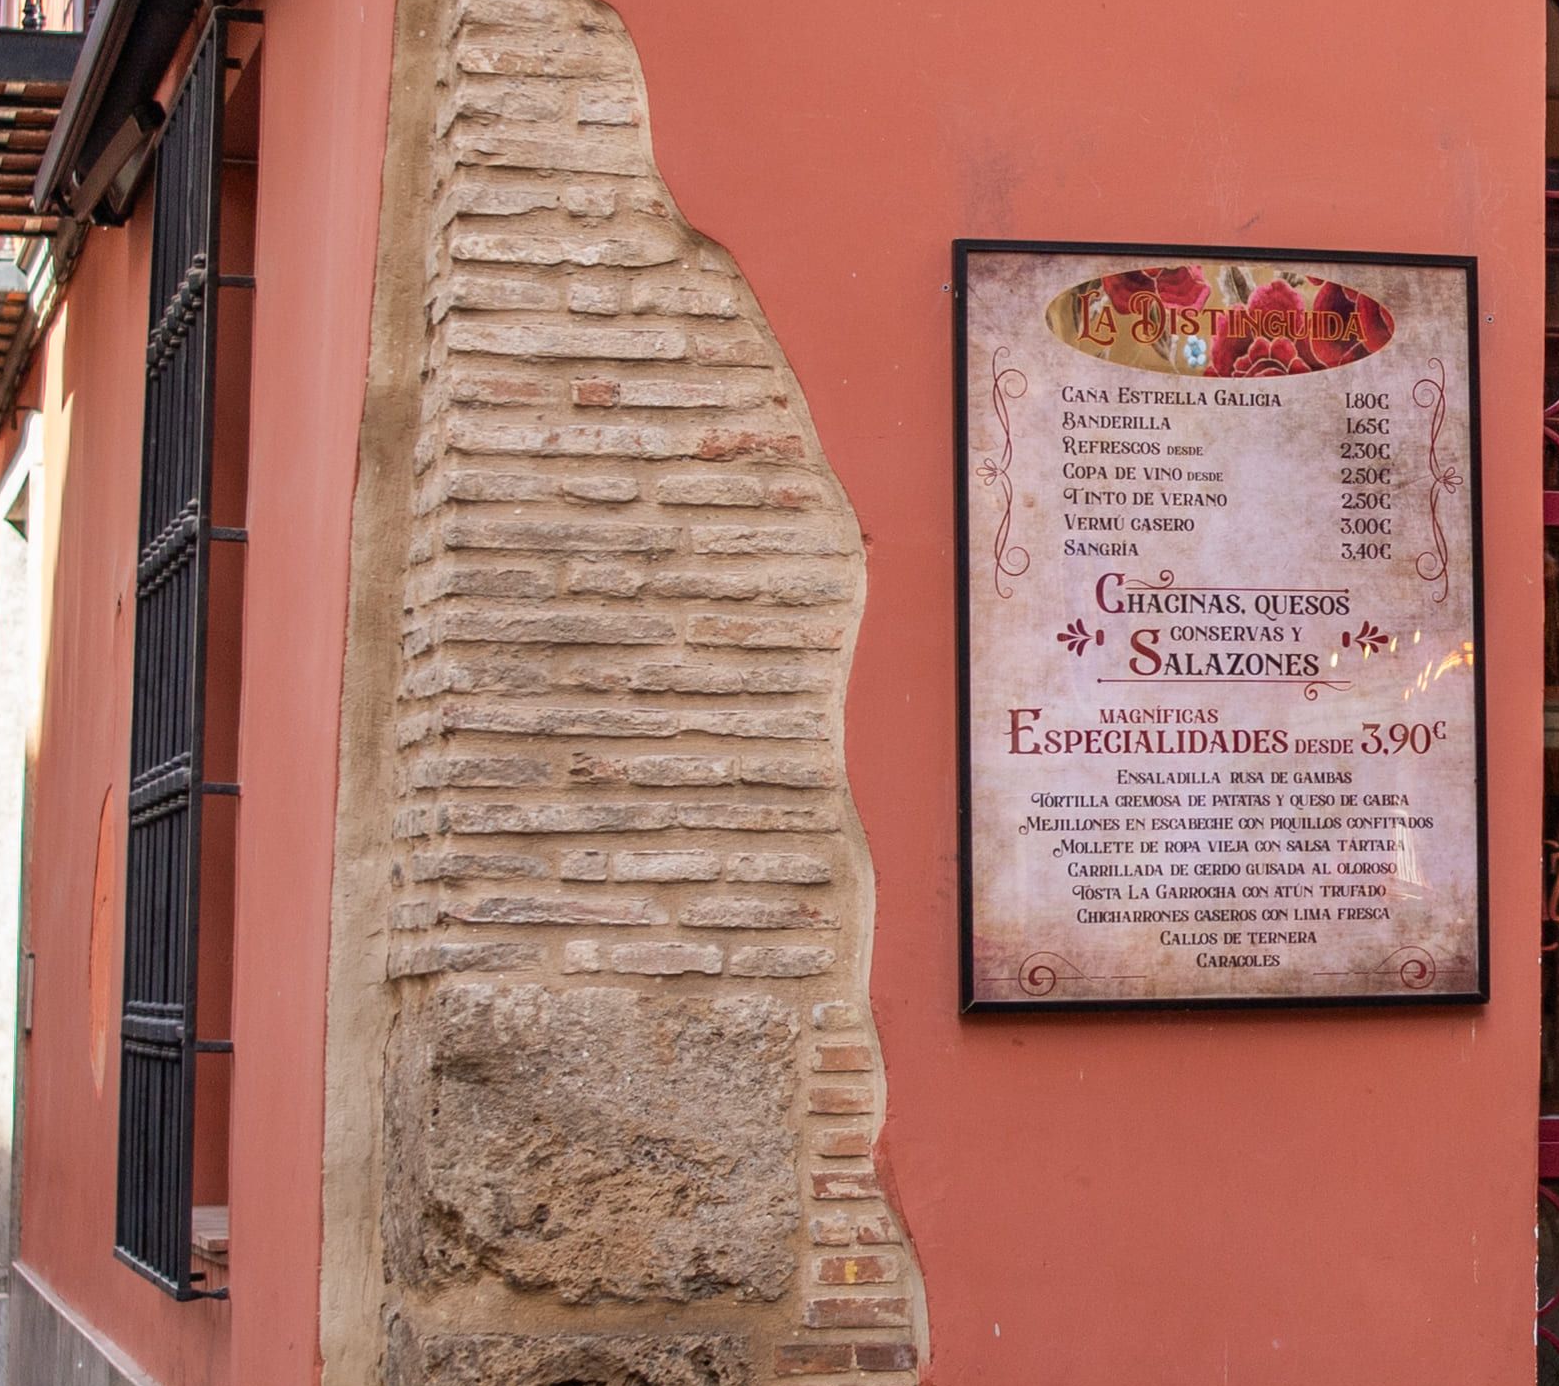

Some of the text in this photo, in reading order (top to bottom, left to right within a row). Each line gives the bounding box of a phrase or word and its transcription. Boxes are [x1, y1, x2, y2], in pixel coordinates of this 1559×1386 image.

[1078, 291, 1367, 345] LA DISTINGUIDA
[1061, 386, 1109, 403] CAÑA
[1118, 389, 1207, 405] ESTRELLA
[1214, 389, 1282, 407] GALICIA
[1062, 412, 1171, 430] BANDERILLA
[1062, 436, 1160, 455] REFRESCOS
[1167, 446, 1204, 456] DESDE
[1063, 463, 1107, 481] COPA
[1115, 465, 1137, 481] DE
[1143, 465, 1182, 481] VINO
[1187, 471, 1223, 482] DESDE
[1063, 488, 1127, 506] TINTO
[1133, 492, 1154, 506] DE
[1161, 493, 1227, 507] VERANO
[1064, 513, 1125, 532] VERMÚ
[1131, 518, 1195, 533] CASERO
[1064, 539, 1139, 557] SANGRÍA
[1254, 594, 1350, 622] QUESOS
[1170, 626, 1302, 642] CONSERVAS Y
[1129, 628, 1319, 676] SALAZONES
[1099, 705, 1219, 724] MAGNÍFICAS
[1002, 708, 1288, 755] ESPECIALIDADES
[1295, 738, 1353, 755] DESDE
[1117, 769, 1352, 785] ENSALADILLA RUSA DE GAMBAS
[1031, 793, 1409, 810] TORTILLA CREMOSA DE PATATAS Y QUESO DE CABRA
[1018, 816, 1433, 835] MEJILLONES EN ESCABECHE CON PIQUILLOS CONFITADOS
[1052, 837, 1405, 858] MOLLETE DE ROPA VIEJA CON SALSA TÁRTARA
[1067, 863, 1397, 878] CARRILLADA DE CERDO GUISADA AL OLOROSO
[1072, 882, 1386, 901] TOSTA LA GARROCHA CON ATÚN TRUFADO
[1077, 907, 1390, 924] CHICHARRONES CASEROS CON LIMA FRESCA
[1160, 931, 1316, 945] CALLOS DE TERNERA
[1196, 953, 1280, 968] CARACOLES
